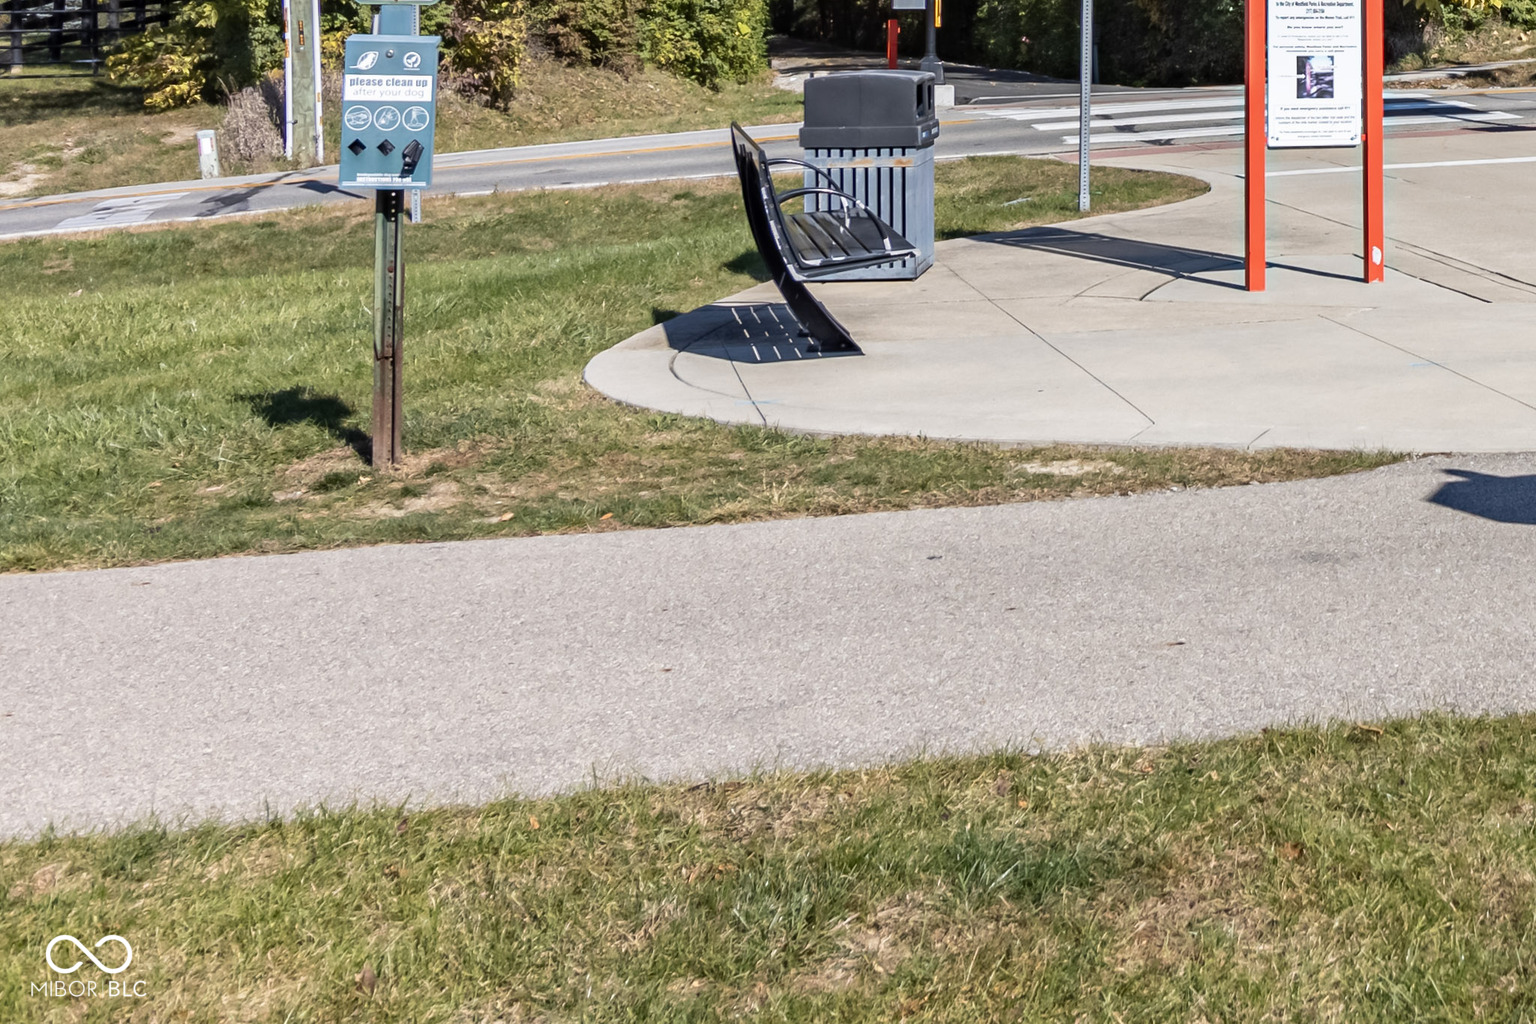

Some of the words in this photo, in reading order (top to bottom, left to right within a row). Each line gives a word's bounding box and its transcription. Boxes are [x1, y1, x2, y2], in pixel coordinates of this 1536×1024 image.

[350, 77, 383, 87] please
[386, 77, 413, 87] clean
[416, 79, 428, 88] up
[353, 87, 376, 96] after
[380, 89, 400, 97] your
[405, 88, 424, 99] dog
